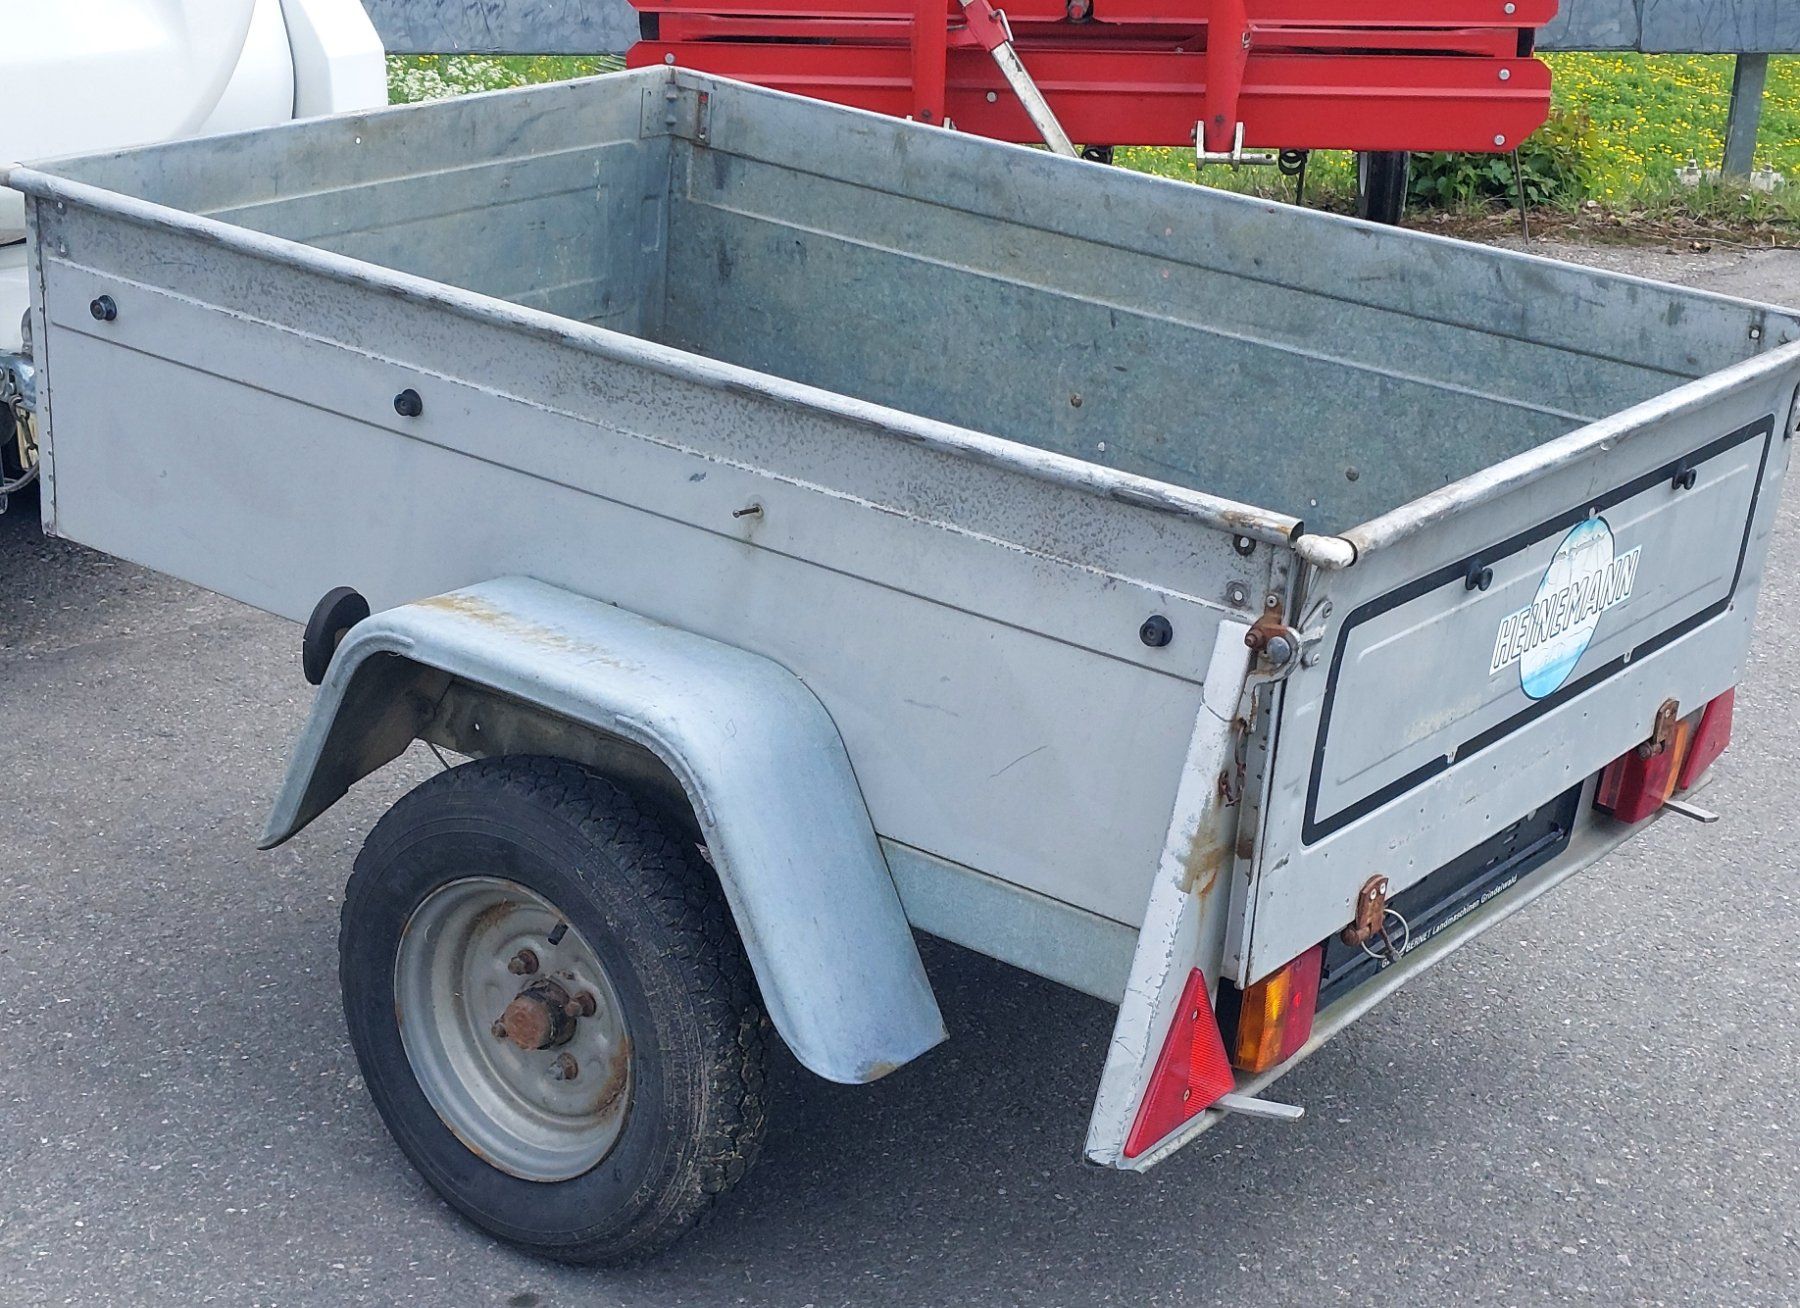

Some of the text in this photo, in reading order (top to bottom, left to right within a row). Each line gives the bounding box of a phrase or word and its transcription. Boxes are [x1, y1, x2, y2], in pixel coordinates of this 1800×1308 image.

[1493, 549, 1639, 669] HEINEMANN
[1432, 899, 1480, 935] Landmaschinen
[1480, 873, 1518, 904] Grindelwald
